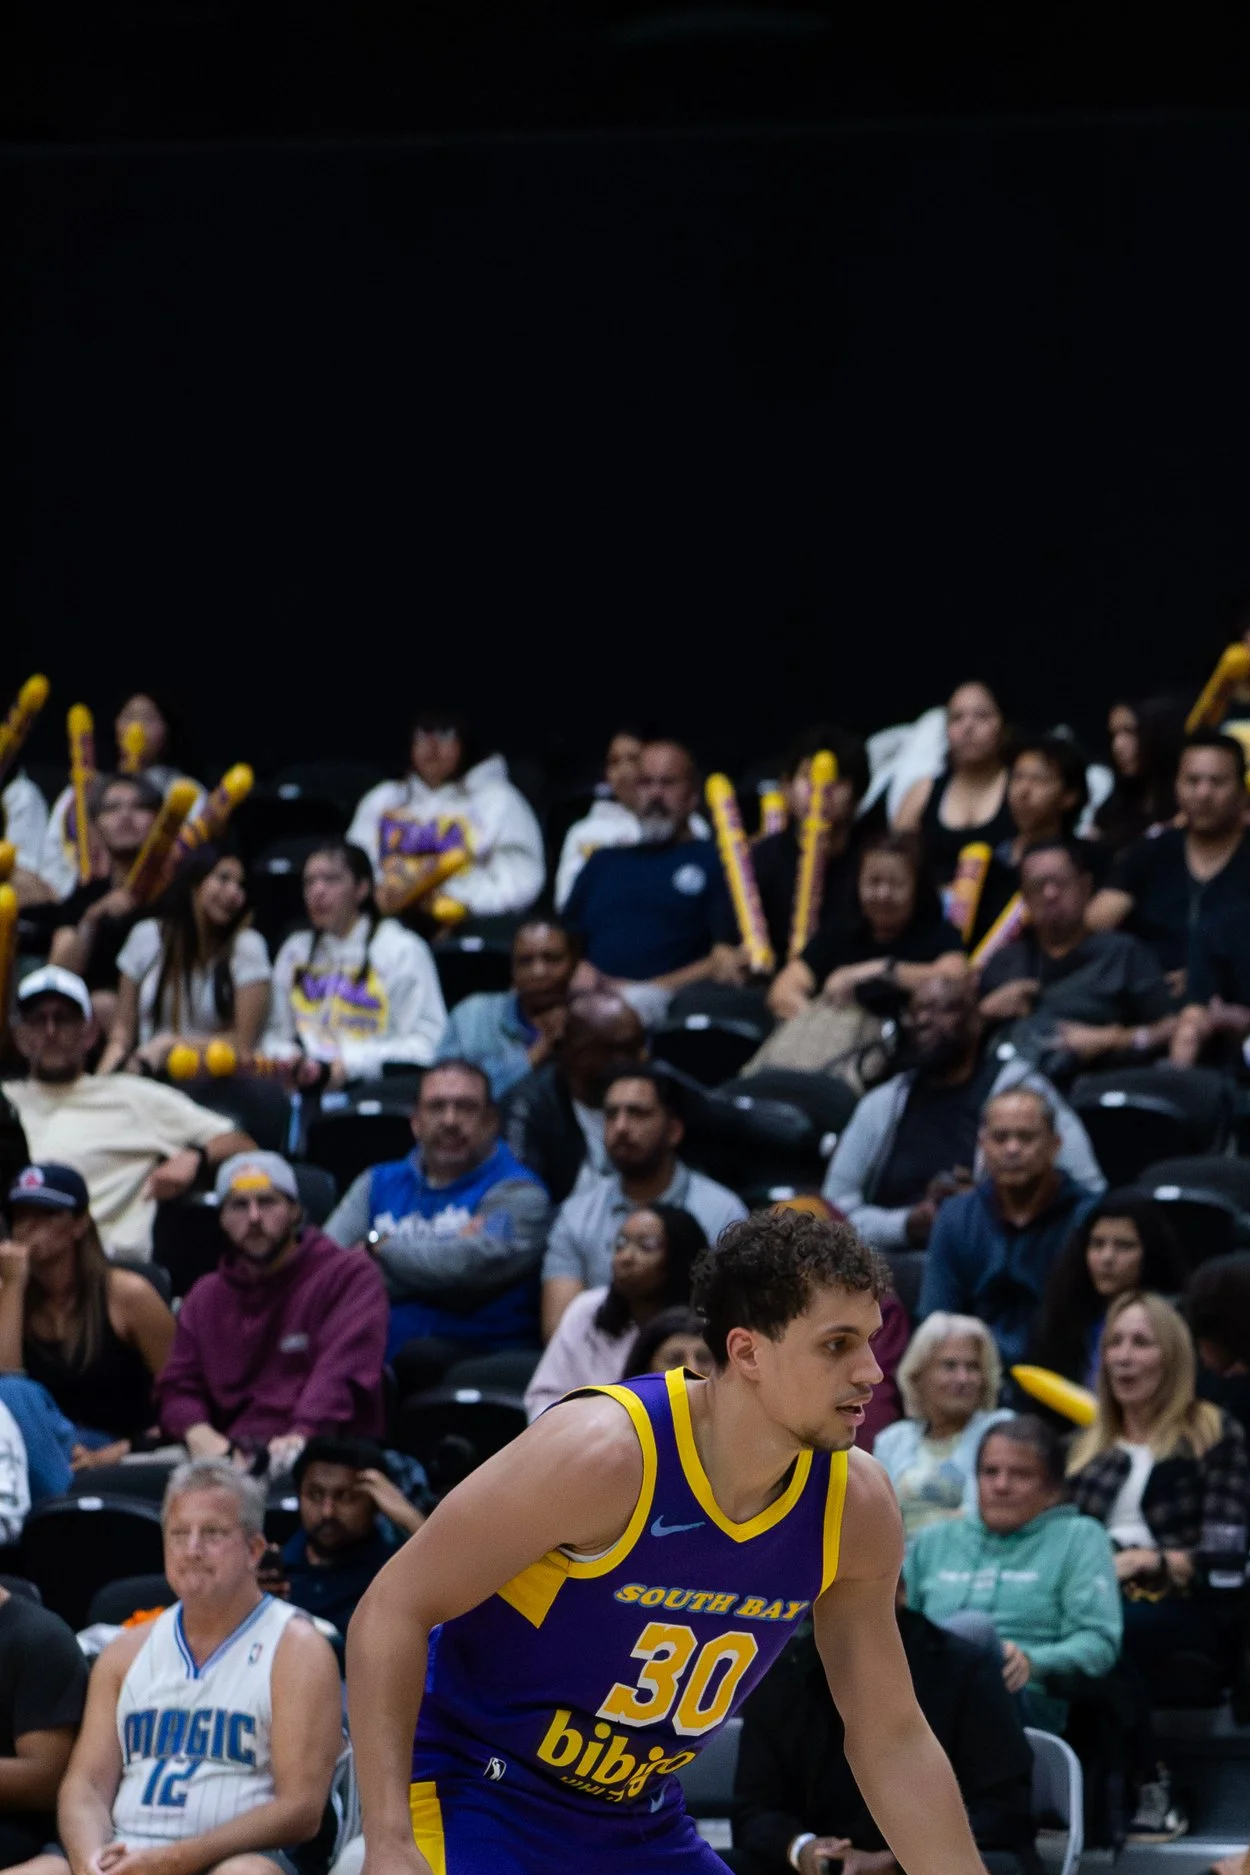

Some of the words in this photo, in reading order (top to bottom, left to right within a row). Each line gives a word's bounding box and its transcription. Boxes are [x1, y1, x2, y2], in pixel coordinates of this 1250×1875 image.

[614, 1583, 739, 1615] SOUTH
[734, 1596, 810, 1620] BAY
[595, 1621, 758, 1737] 30
[124, 1708, 258, 1769] MAGIC
[141, 1756, 203, 1807] 12
